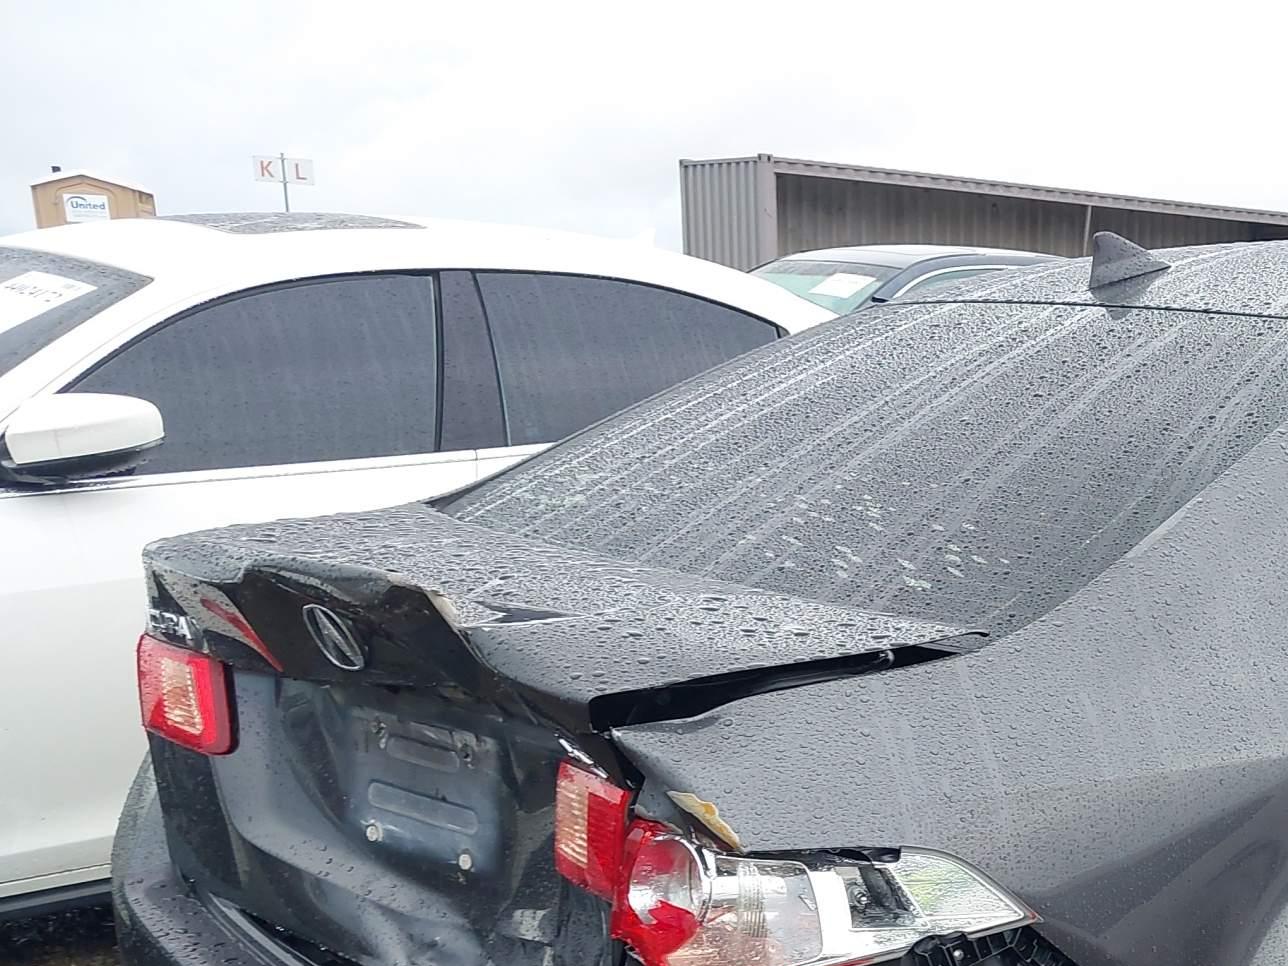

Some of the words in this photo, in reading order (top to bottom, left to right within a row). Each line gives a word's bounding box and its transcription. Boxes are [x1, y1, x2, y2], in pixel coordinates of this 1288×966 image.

[260, 160, 275, 178] K
[295, 163, 308, 180] L
[70, 200, 106, 210] United
